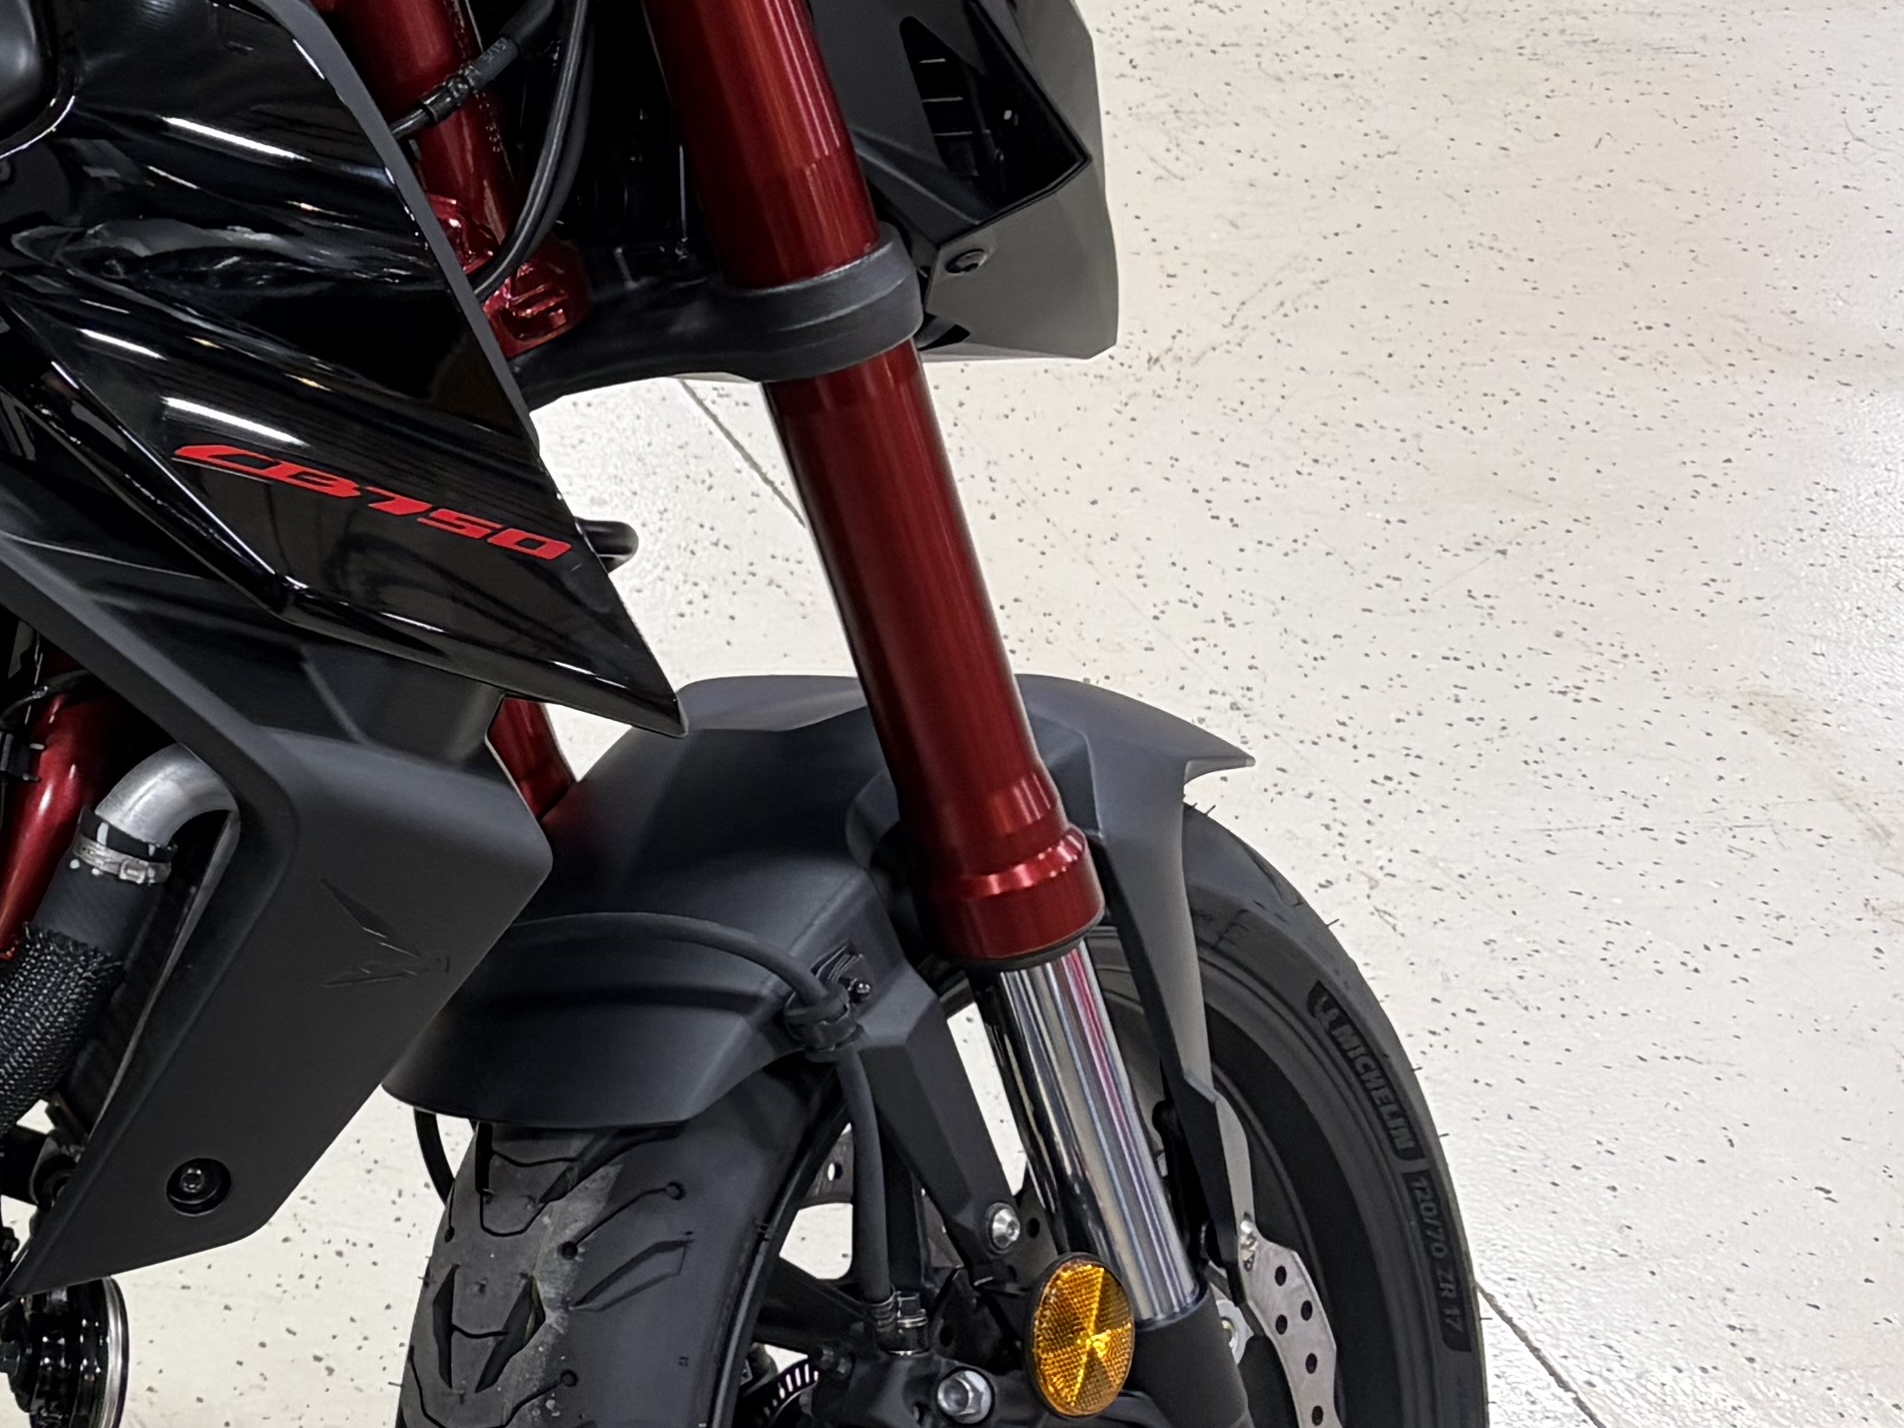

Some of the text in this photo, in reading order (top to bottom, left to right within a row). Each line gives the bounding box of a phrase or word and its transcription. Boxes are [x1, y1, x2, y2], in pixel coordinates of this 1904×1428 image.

[173, 443, 573, 560] CB750
[1332, 1023, 1414, 1151] MICHELIN
[1413, 1177, 1447, 1258] 120/70
[1444, 1308, 1462, 1332] 17
